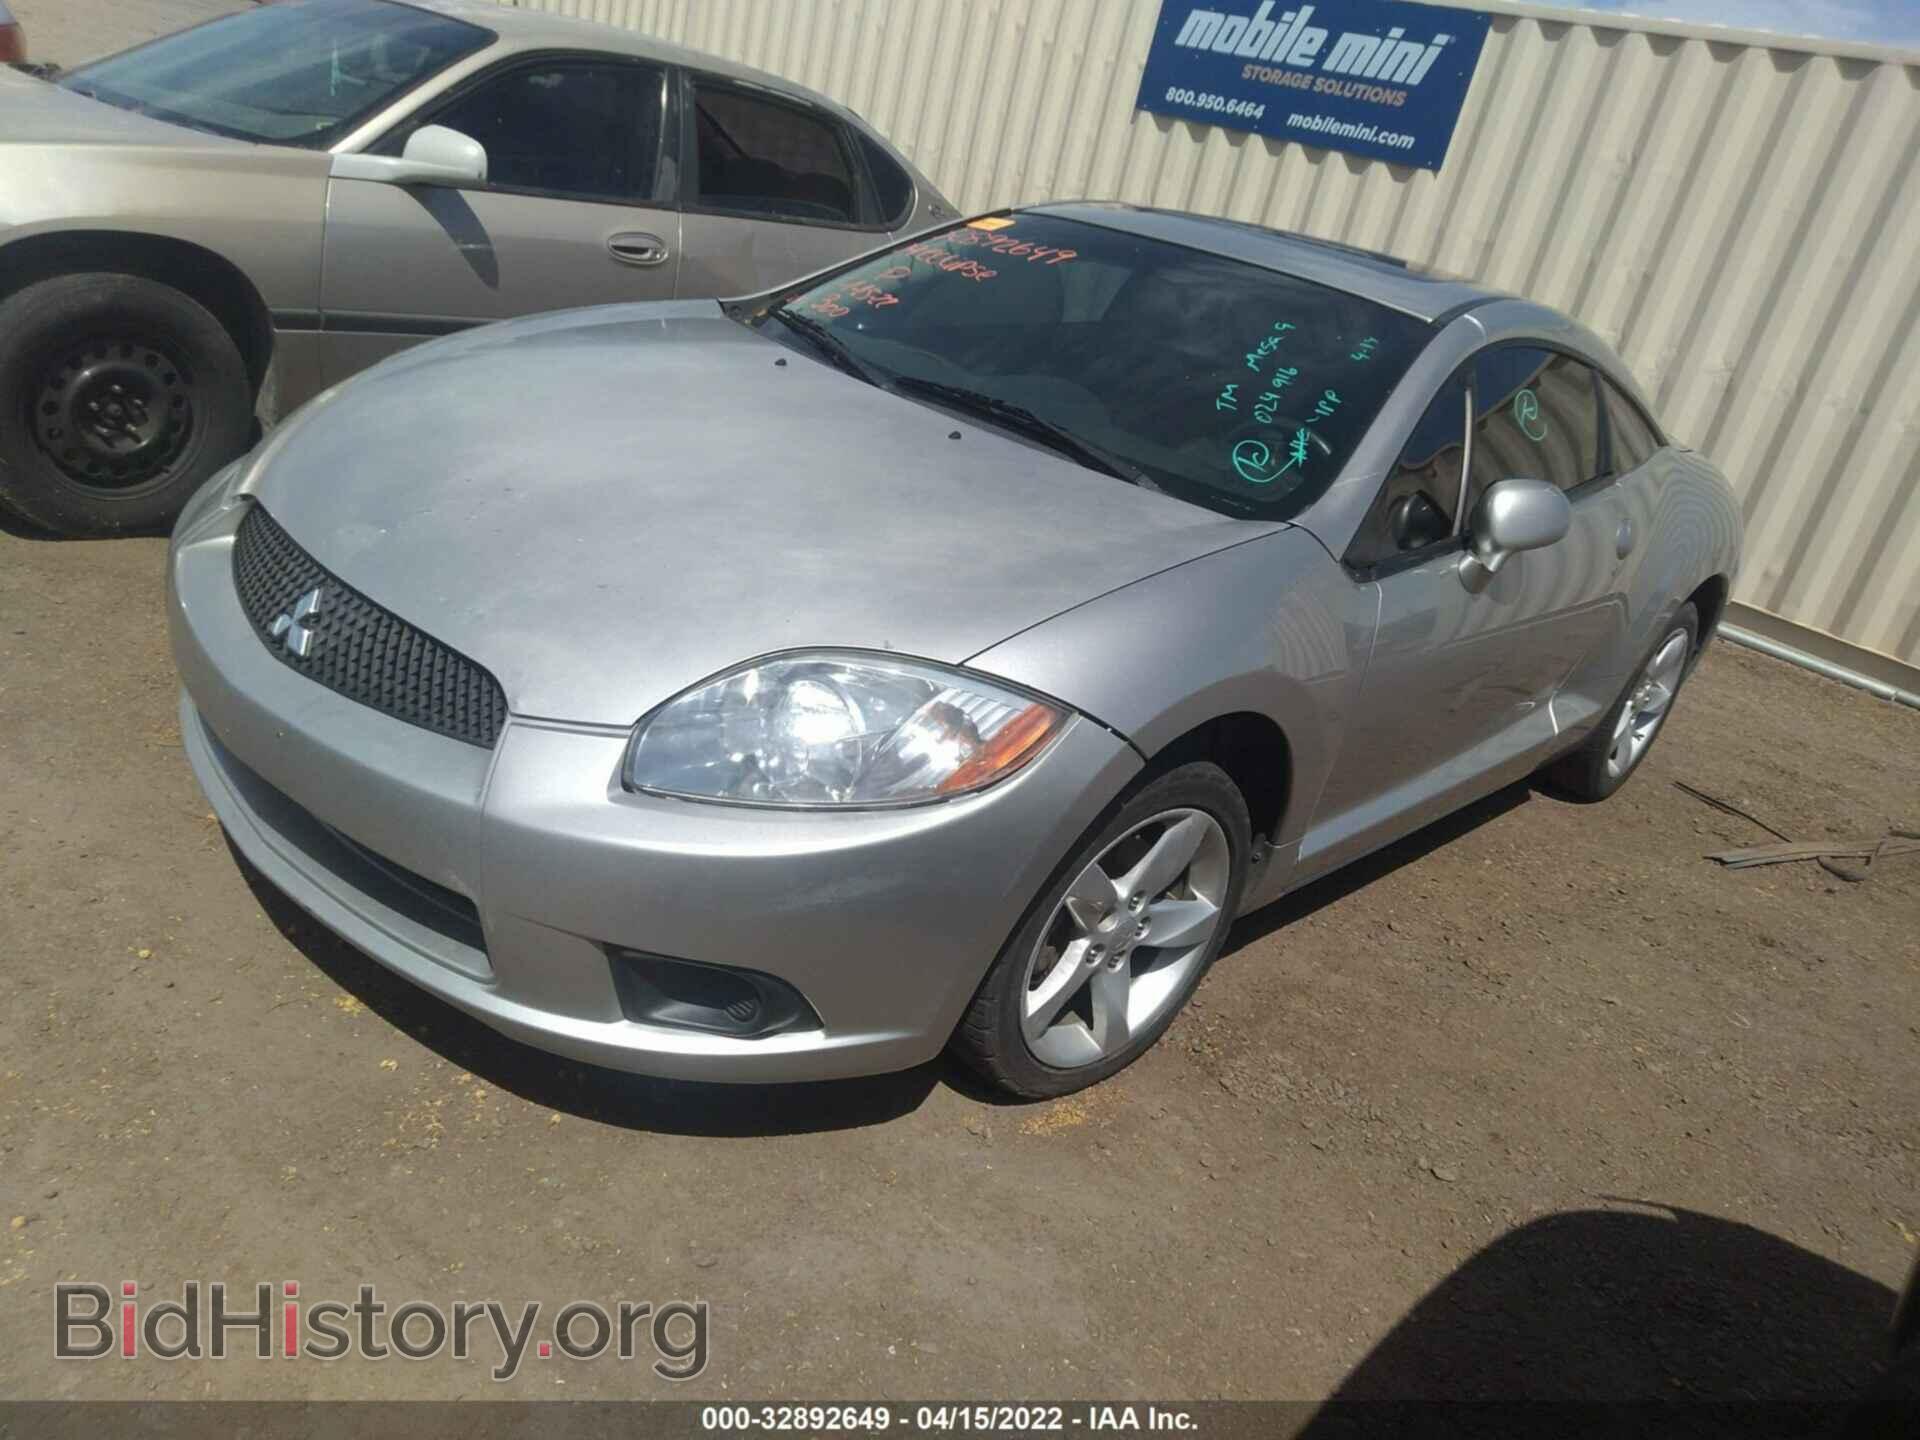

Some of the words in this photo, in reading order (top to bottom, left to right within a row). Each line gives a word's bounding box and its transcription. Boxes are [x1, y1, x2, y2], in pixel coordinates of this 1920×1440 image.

[1174, 0, 1328, 67] mobile
[1322, 27, 1450, 86] mini
[1165, 87, 1265, 119] 800.950.6464
[1242, 63, 1312, 90] STORAGE
[1313, 76, 1407, 107] SOLUTIONS
[1287, 111, 1415, 149] mobilemini.com
